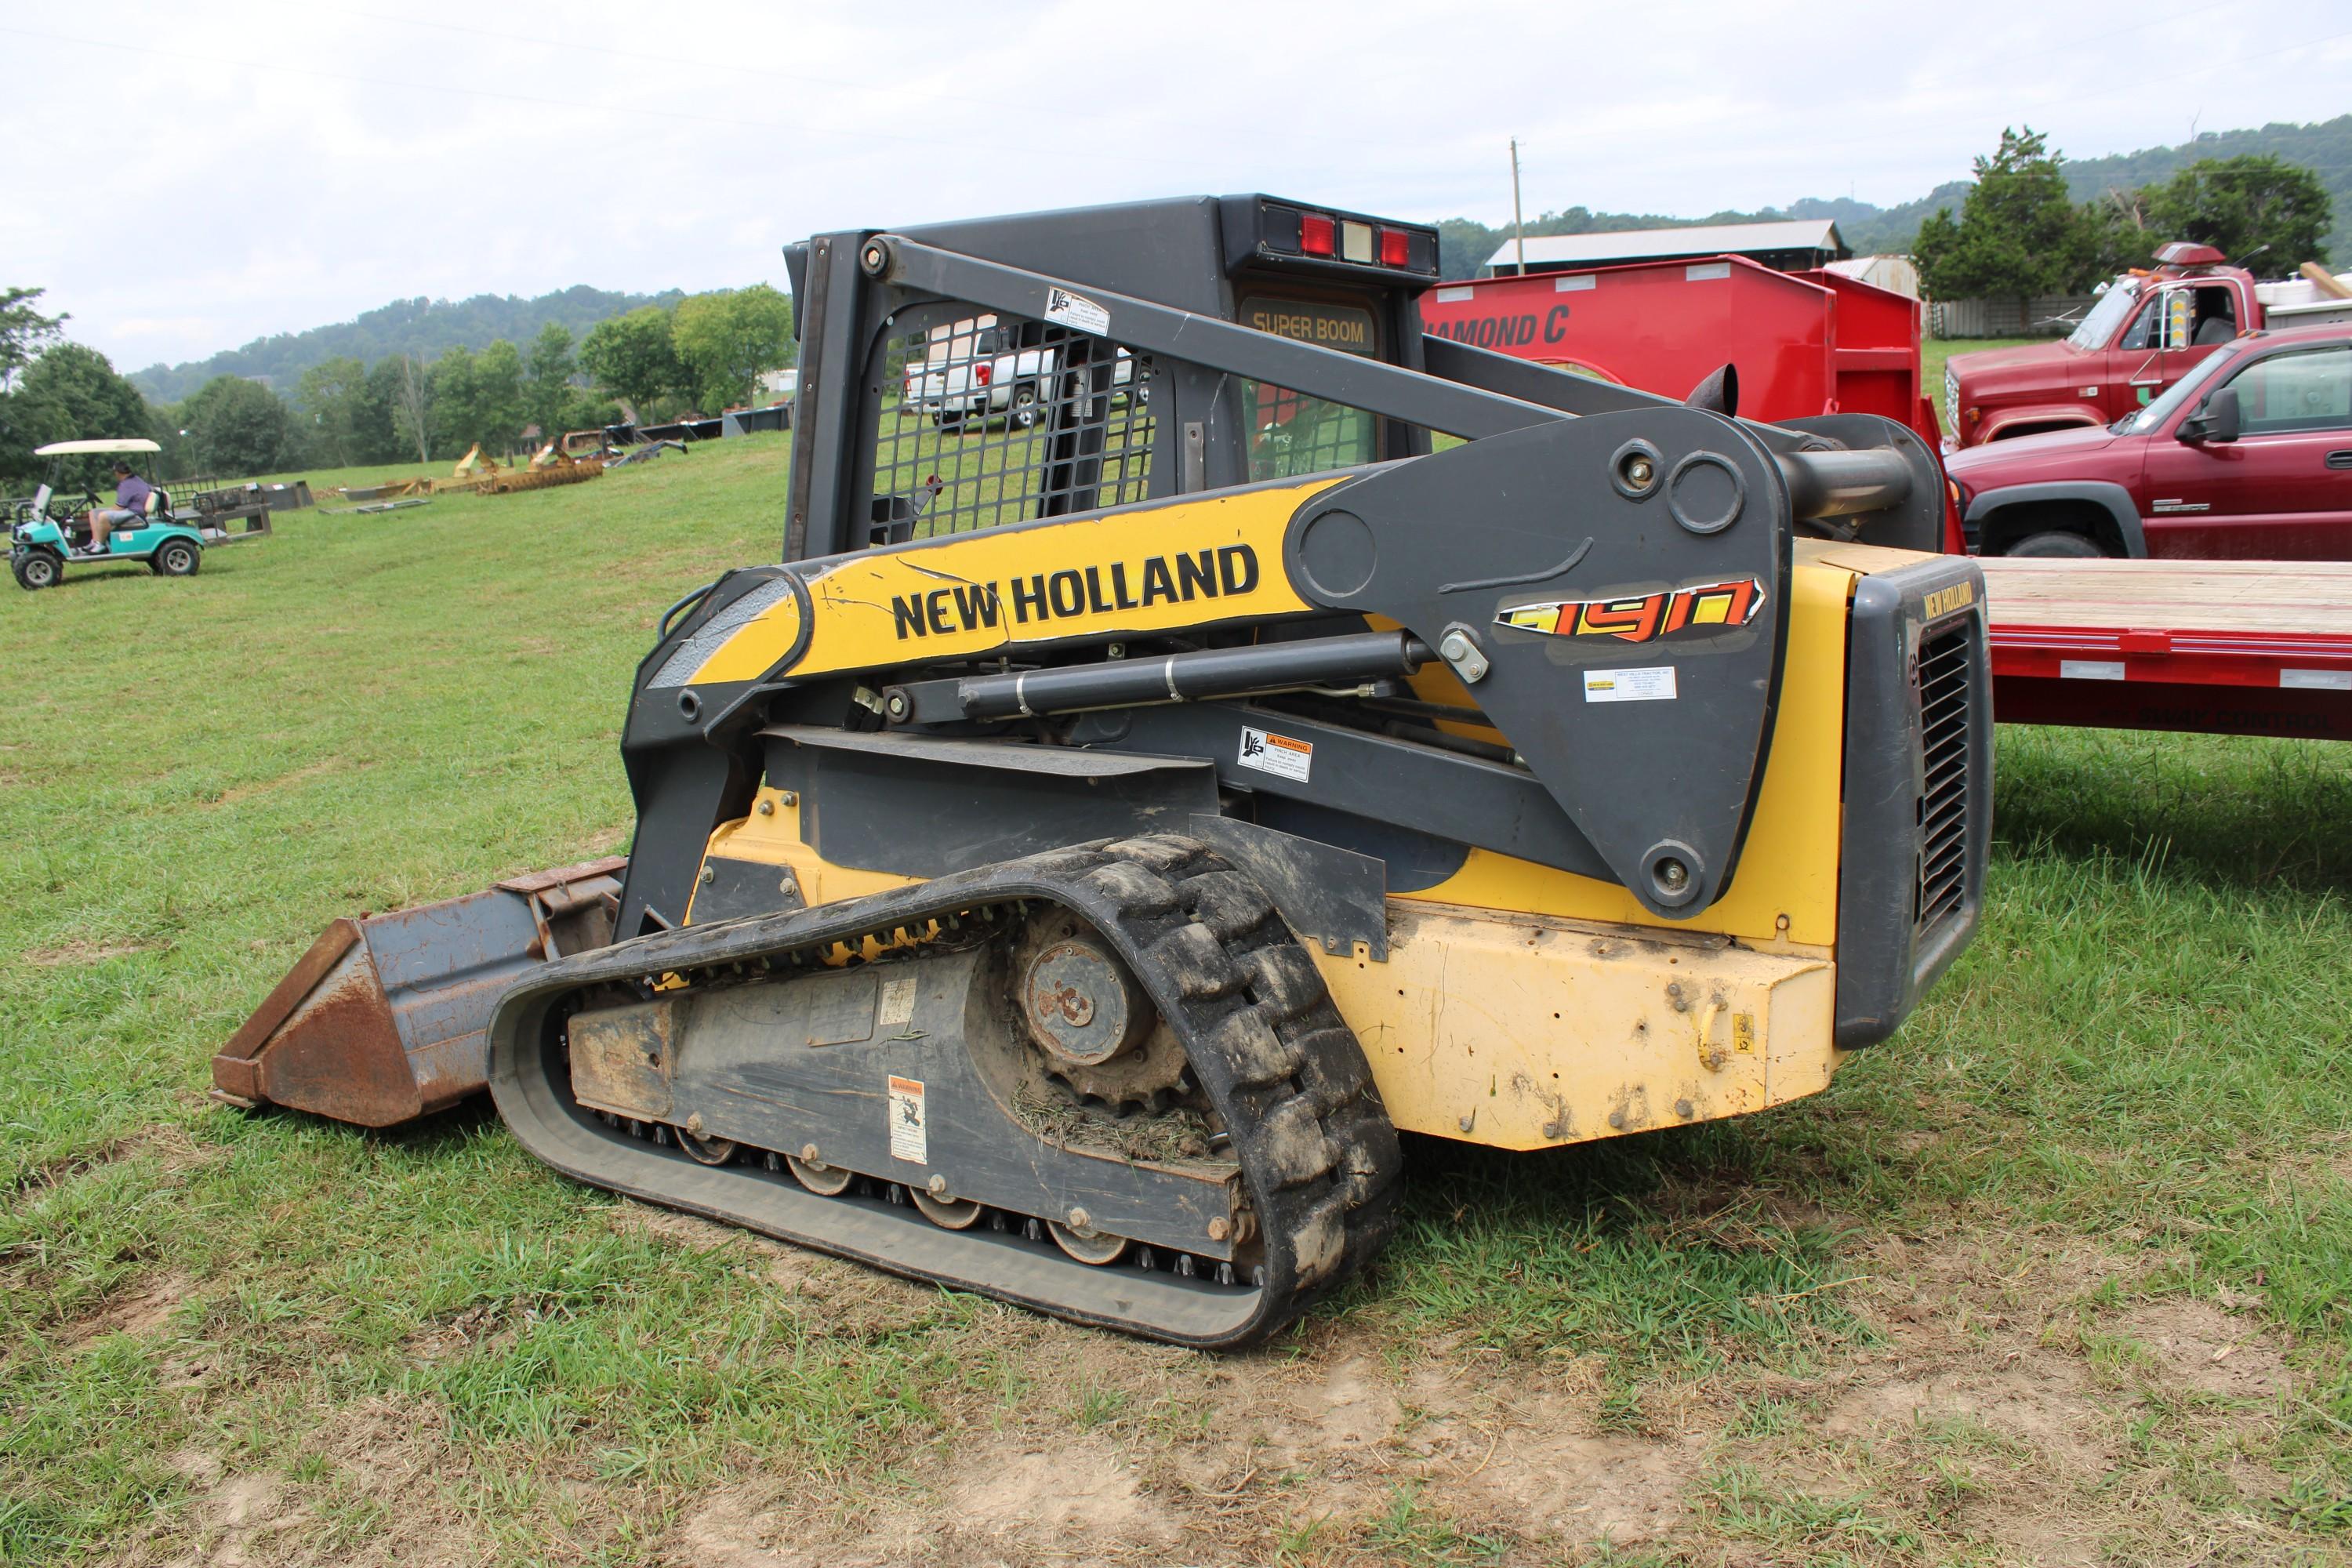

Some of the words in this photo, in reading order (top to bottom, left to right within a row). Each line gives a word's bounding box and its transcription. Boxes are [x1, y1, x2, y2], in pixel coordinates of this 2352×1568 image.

[1253, 312, 1312, 339] SUPER
[1316, 318, 1363, 343] BOOM
[1421, 314, 1537, 347] AMOND
[1543, 303, 1570, 344] C
[891, 579, 999, 641] NEW
[1011, 543, 1260, 624] HOLLAND
[1924, 590, 1943, 620] NEW
[1941, 581, 1973, 613] HOLLAND
[1277, 739, 1308, 751] WARNING
